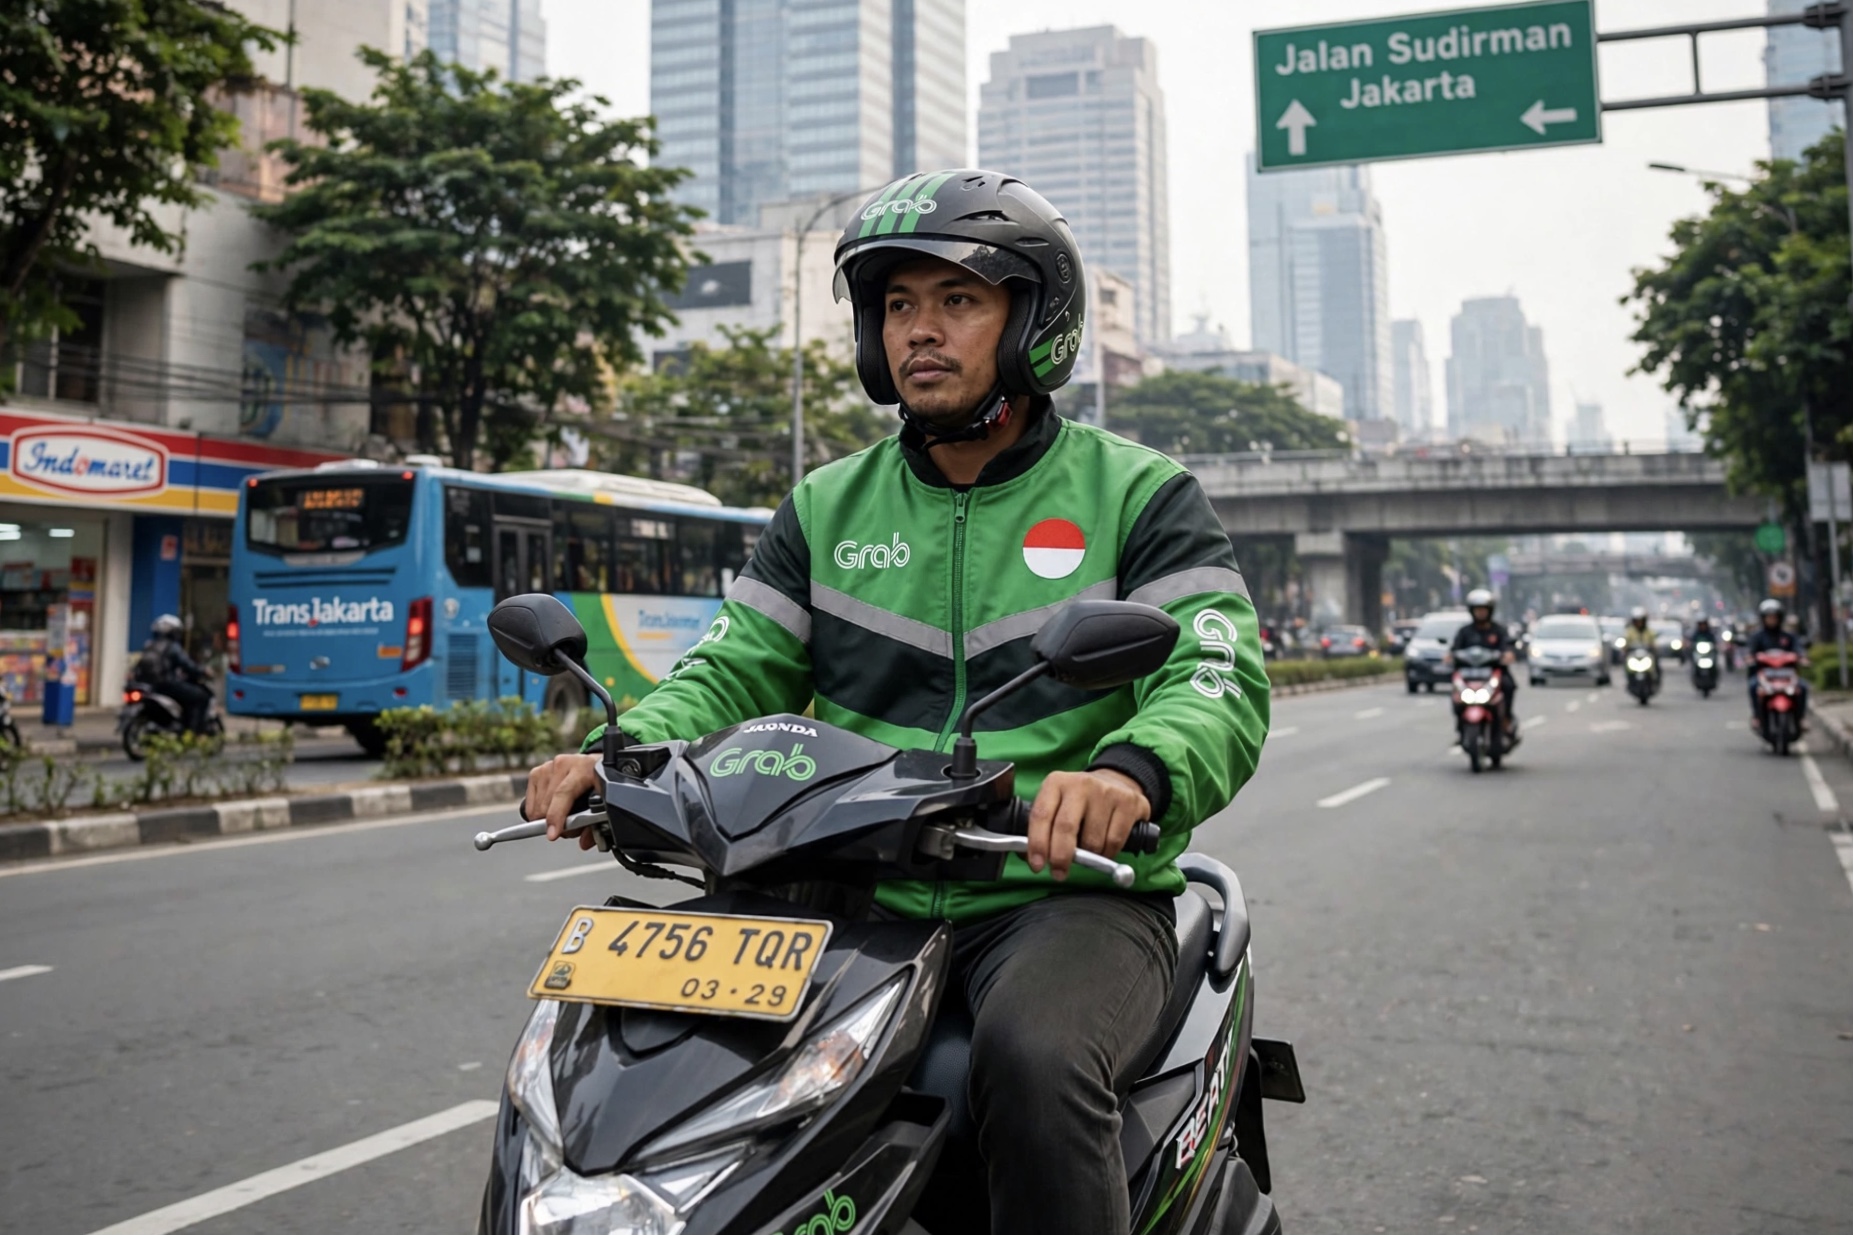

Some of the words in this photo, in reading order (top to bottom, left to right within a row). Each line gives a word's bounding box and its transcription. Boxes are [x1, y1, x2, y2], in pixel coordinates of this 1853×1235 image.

[1275, 40, 1373, 75] Jalan
[1387, 22, 1573, 64] Sudirman
[1340, 71, 1476, 109] Jakarta
[860, 194, 938, 220] Grab
[24, 441, 155, 482] Indomaret
[833, 531, 911, 570] Grab
[252, 597, 395, 627] TransJakarta
[1189, 608, 1242, 699] Grab
[709, 743, 817, 781] Grab
[561, 917, 594, 955] B
[608, 920, 714, 962] 4756
[733, 928, 813, 971] TQR
[771, 1188, 856, 1235] ab
